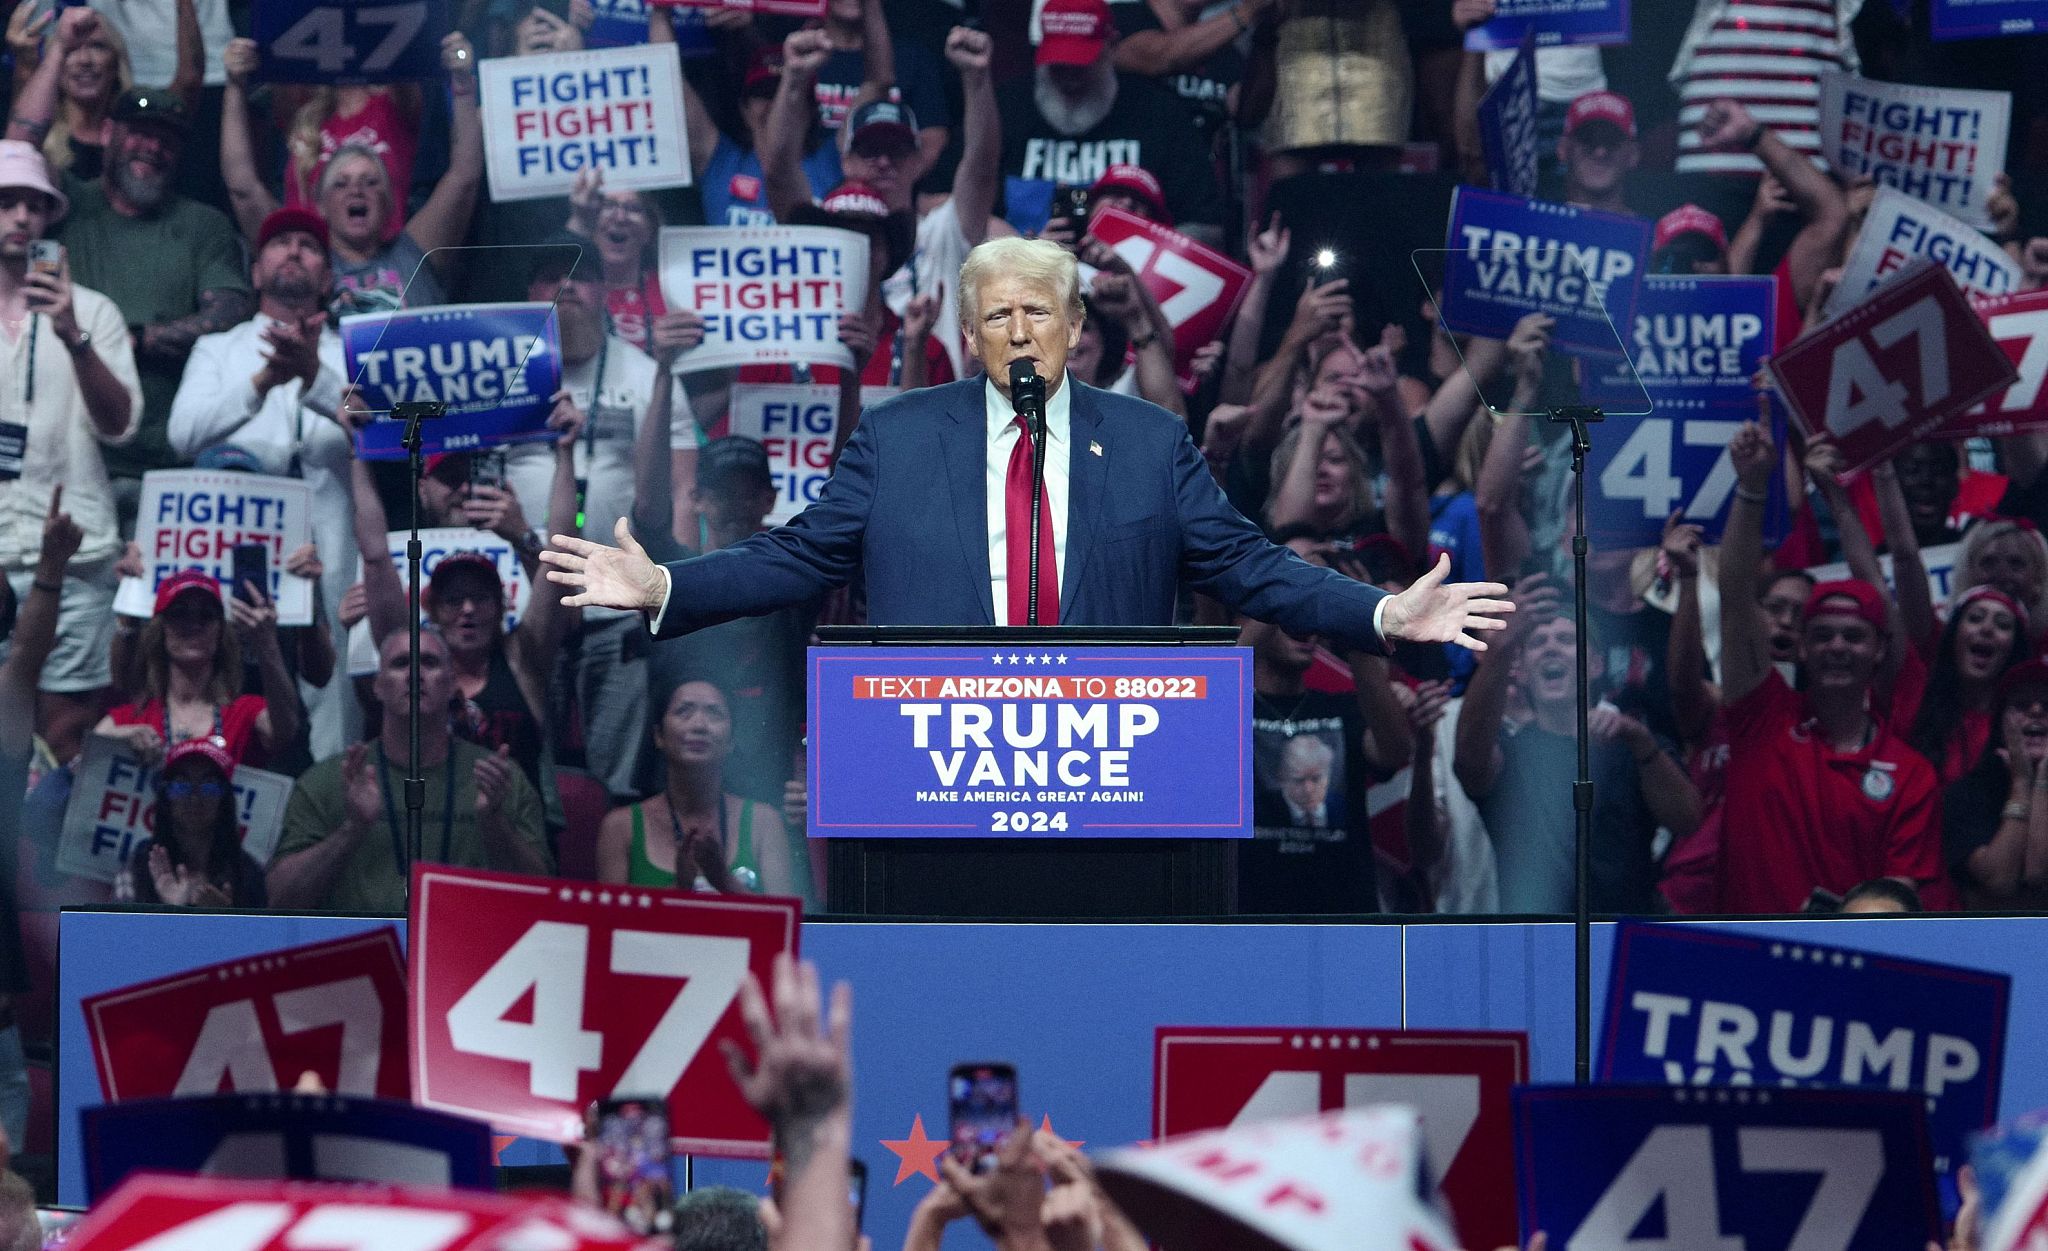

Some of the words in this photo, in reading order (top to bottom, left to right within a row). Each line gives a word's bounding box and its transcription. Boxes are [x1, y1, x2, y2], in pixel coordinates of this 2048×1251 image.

[270, 1, 428, 72] 47
[511, 64, 651, 107] FIGHT!
[515, 101, 654, 141] FIGHT!
[1844, 90, 1982, 140] FIGHT!
[518, 135, 659, 176] FIGHT!
[1841, 119, 1978, 175] FIGHT!
[691, 246, 843, 278] FIGHT!
[1461, 224, 1635, 286] TRUMP
[694, 280, 845, 310] FIGHT!
[1475, 260, 1610, 308] VANCE
[356, 334, 547, 387] TRUMP
[1823, 295, 1950, 438] 47
[381, 365, 531, 406] VANCE
[1601, 418, 1757, 520] 47
[157, 493, 285, 530] FIGHT!
[864, 677, 931, 697] TEXT
[939, 677, 1063, 697] ARIZONA
[1071, 677, 1106, 697] TO
[1114, 677, 1196, 698] 88022
[900, 703, 1160, 749] TRUMP
[929, 750, 1130, 787] VANCE
[916, 791, 959, 802] MAKE
[963, 791, 1032, 802] AMERICA
[1037, 791, 1086, 802] GREAT
[1090, 791, 1144, 802] AGAIN!
[991, 811, 1069, 832] 2024
[447, 920, 751, 1102] 47
[1632, 991, 1981, 1097] TRUMP
[1563, 1124, 1887, 1251] 47
